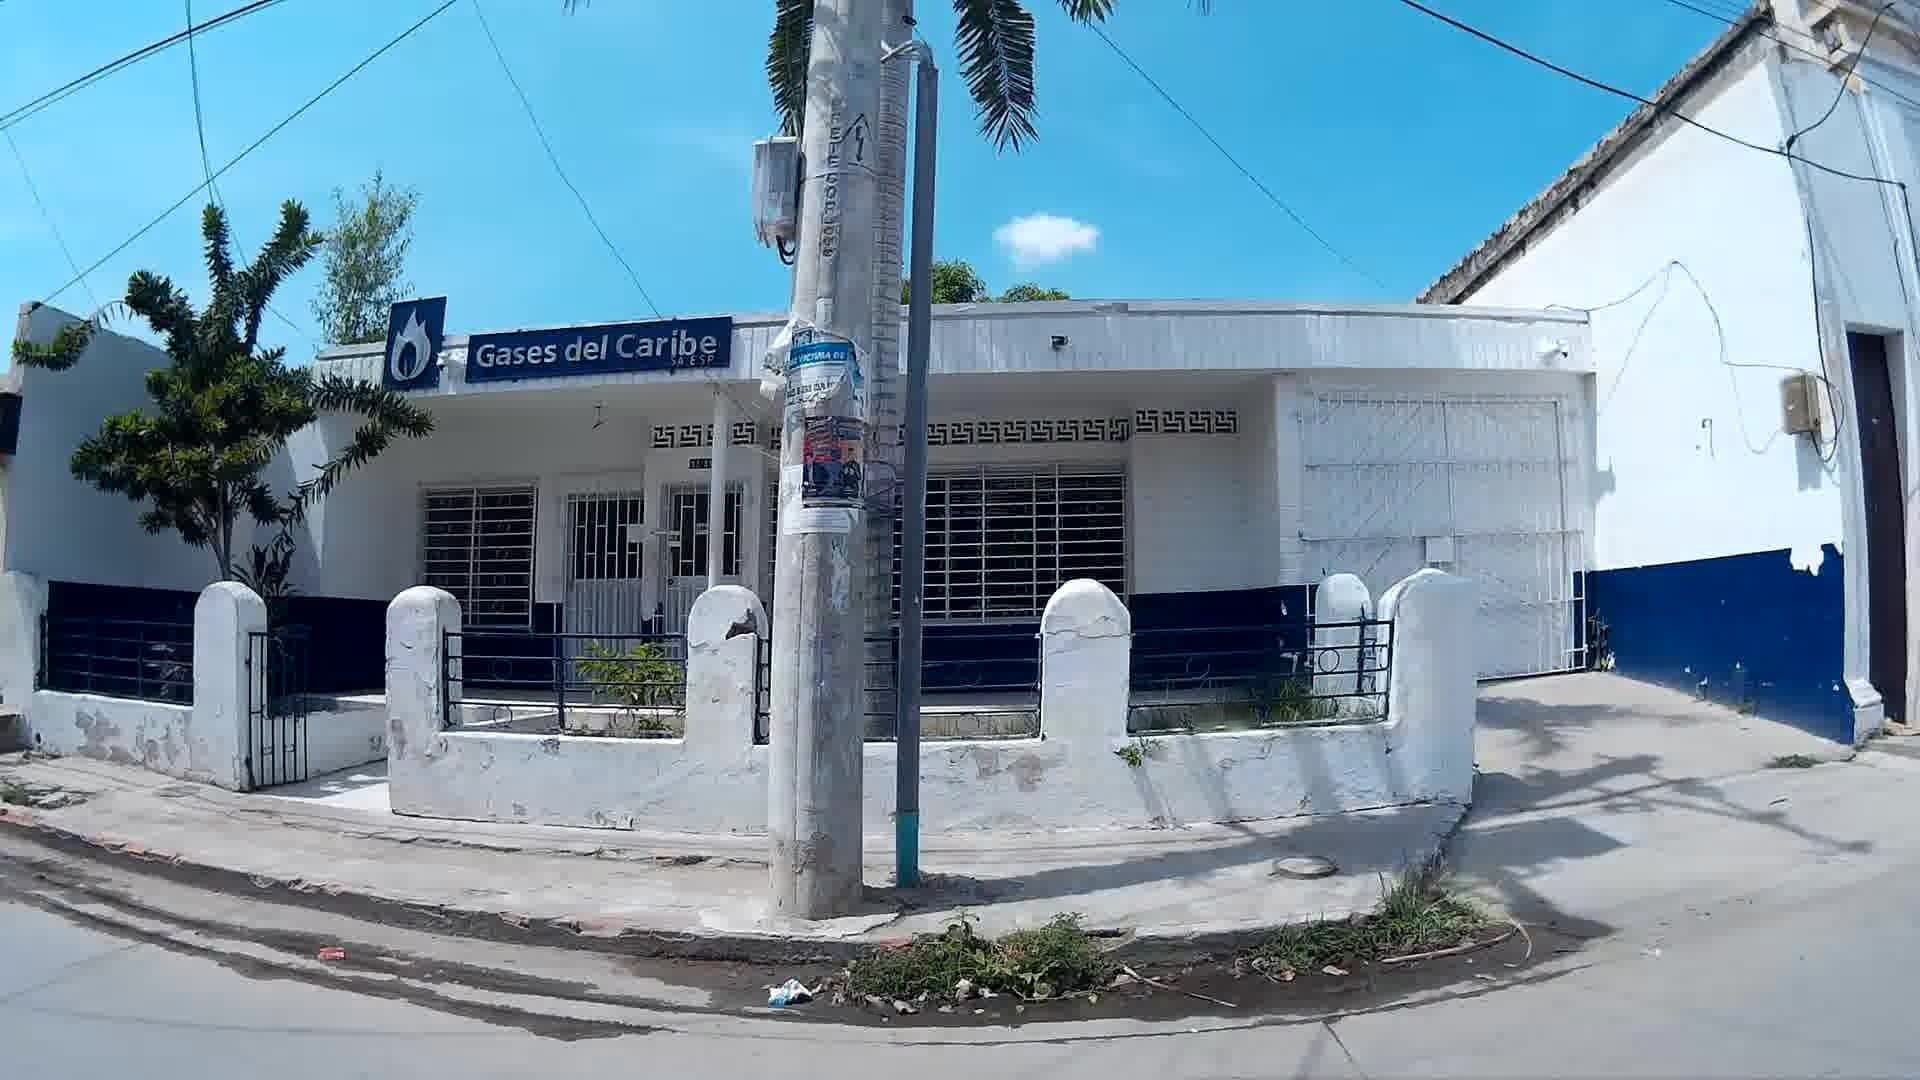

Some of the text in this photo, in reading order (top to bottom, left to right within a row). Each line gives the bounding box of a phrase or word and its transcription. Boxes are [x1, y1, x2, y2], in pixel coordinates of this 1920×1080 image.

[476, 329, 717, 368] Gases del Caribe
